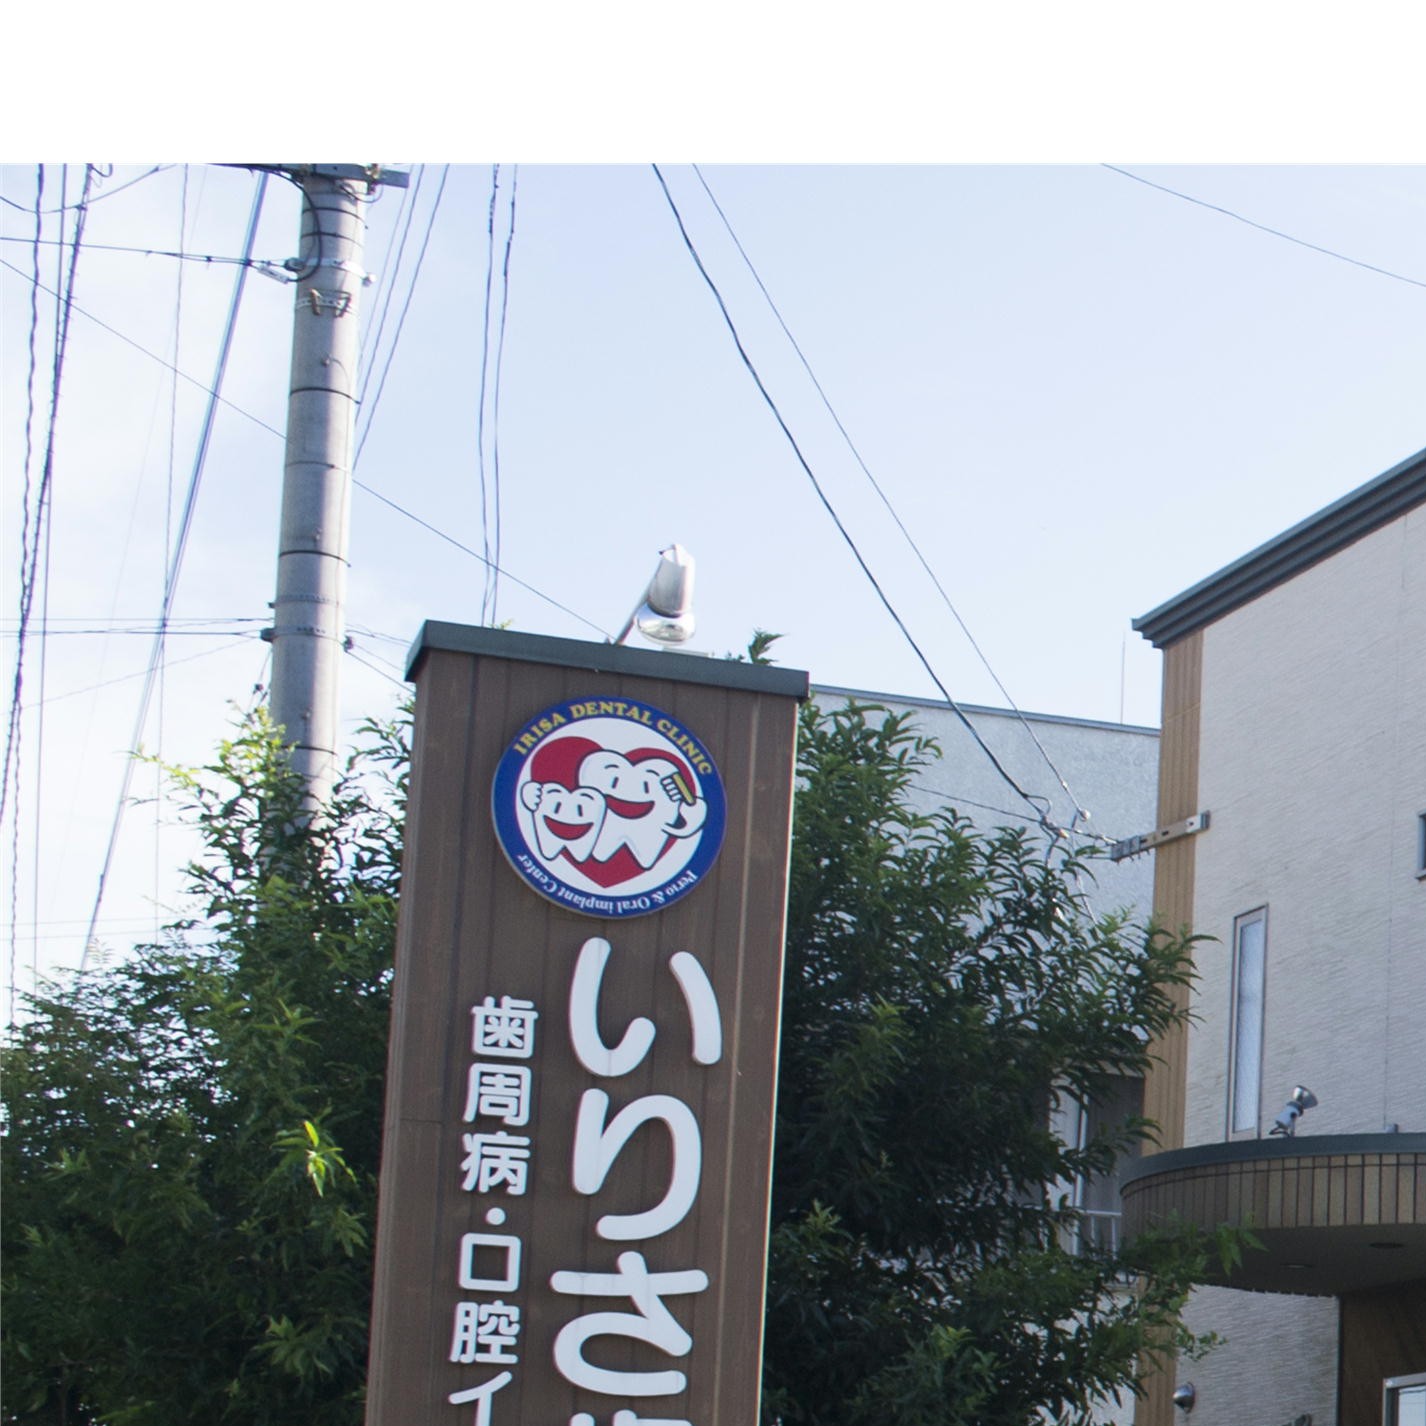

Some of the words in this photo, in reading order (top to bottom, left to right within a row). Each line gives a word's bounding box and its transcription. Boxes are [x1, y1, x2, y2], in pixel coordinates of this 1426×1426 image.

[513, 712, 567, 755] IRISA
[569, 701, 654, 726] DENTAL
[656, 719, 713, 776] CLINIC
[516, 853, 558, 893] Center
[666, 869, 699, 896] Perio
[557, 886, 614, 914] implant
[617, 896, 651, 914] Oral
[651, 890, 665, 904] &
